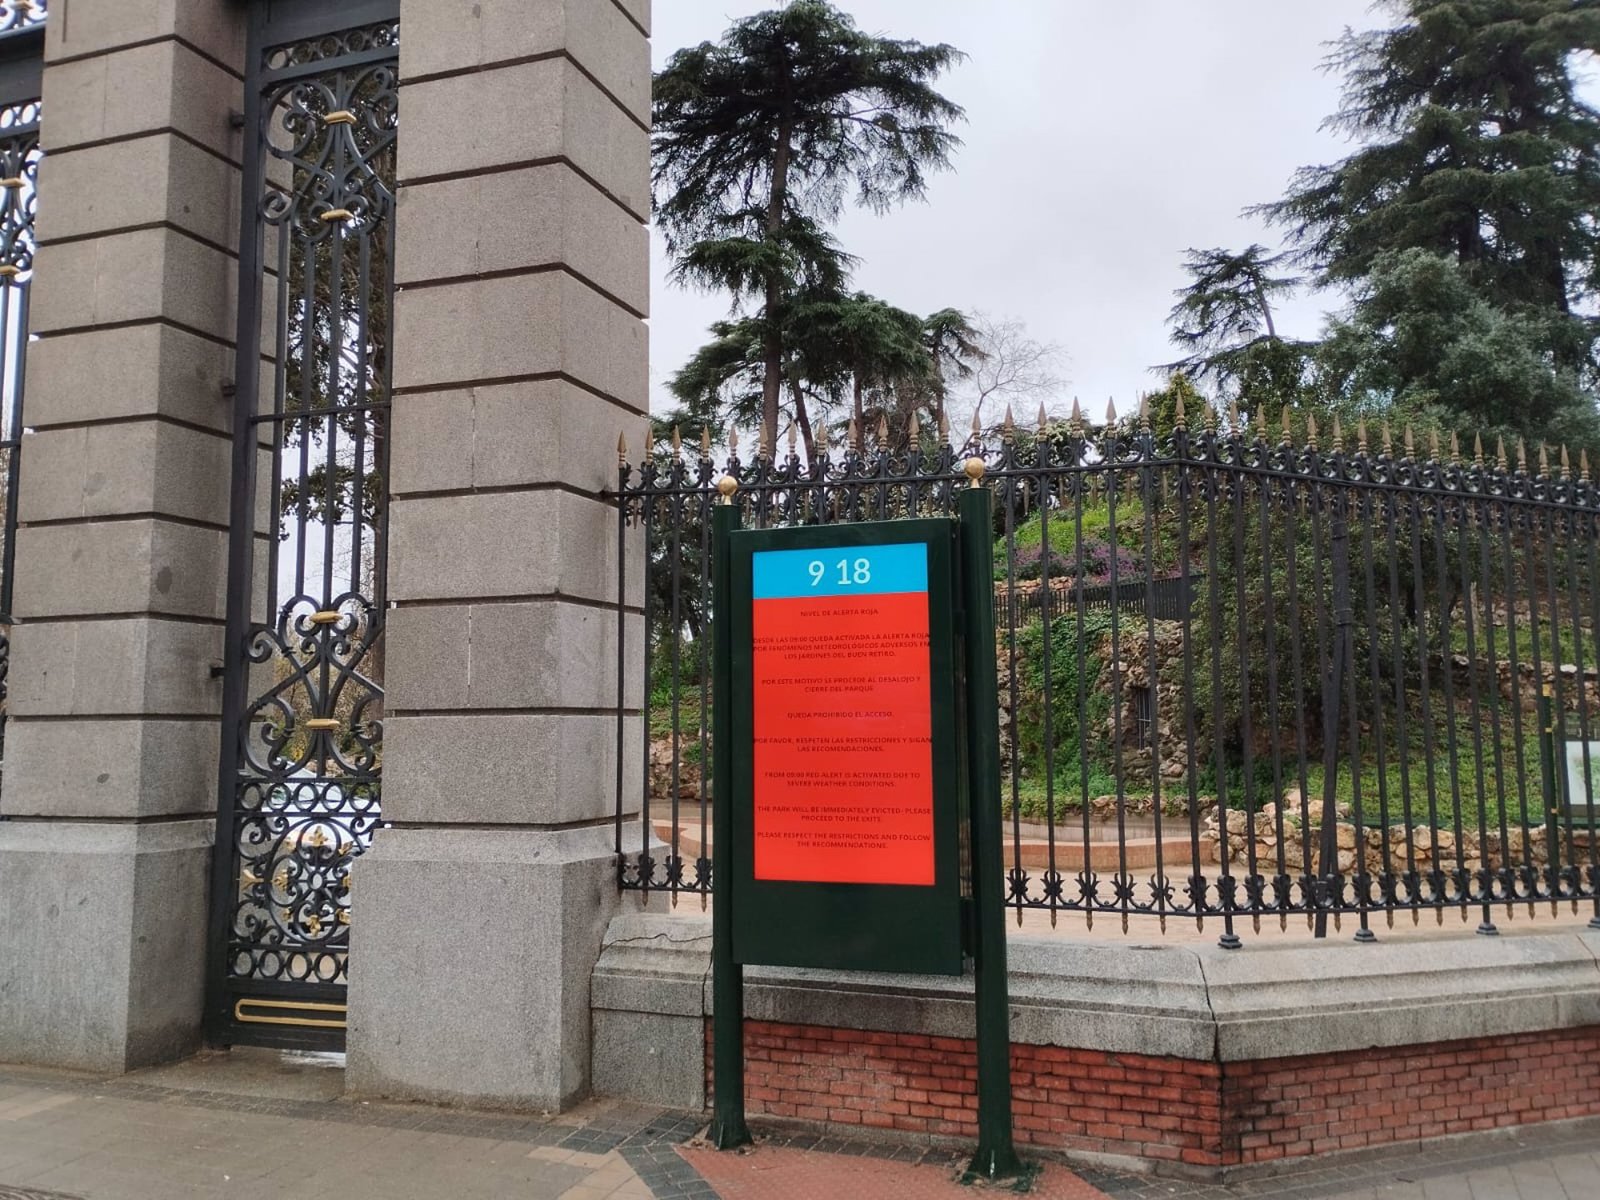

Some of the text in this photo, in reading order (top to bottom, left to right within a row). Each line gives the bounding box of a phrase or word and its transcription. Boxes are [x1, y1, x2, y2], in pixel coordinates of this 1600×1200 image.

[808, 558, 871, 586] 9 18
[808, 635, 834, 643] QUEDA
[798, 652, 831, 660] JARDINES
